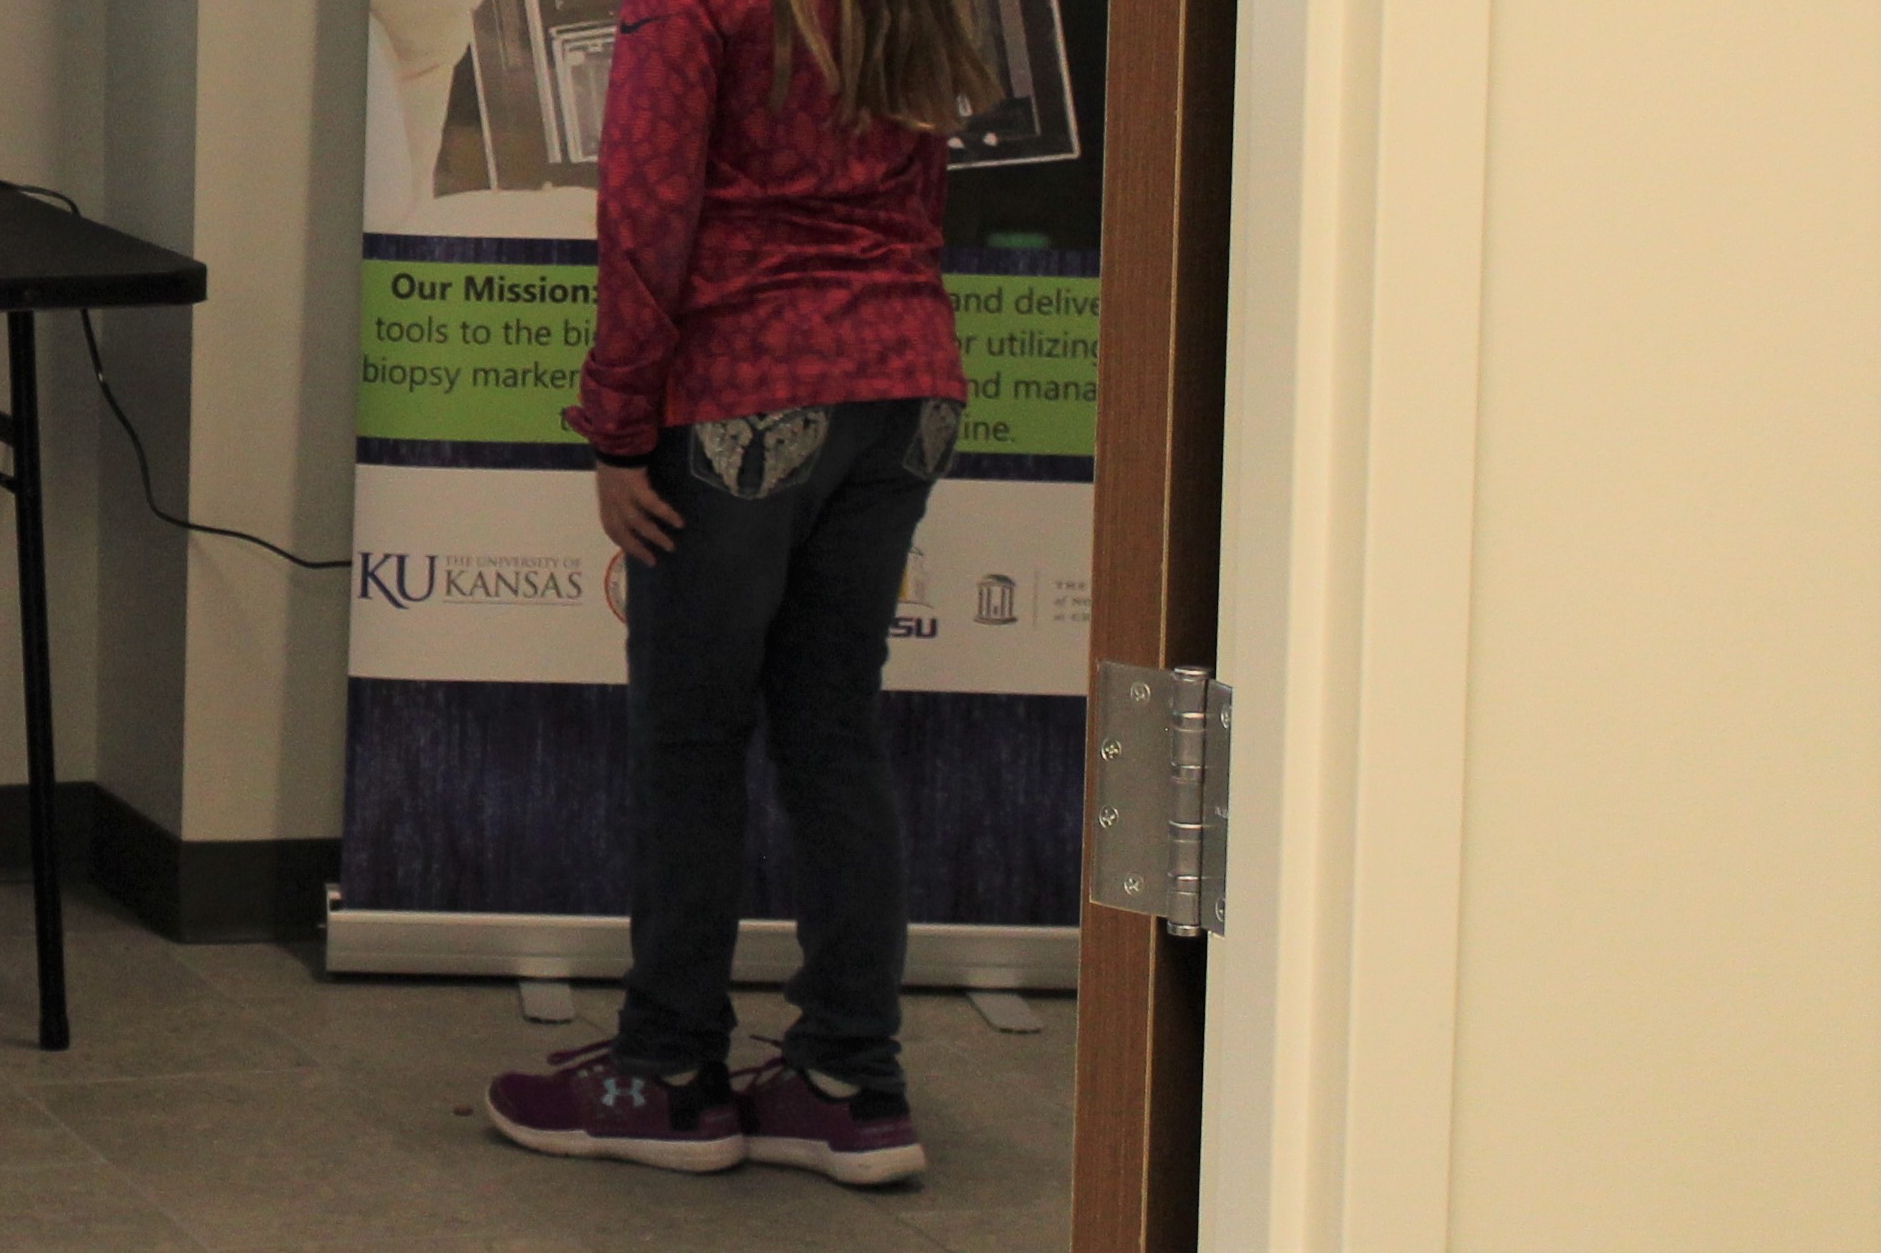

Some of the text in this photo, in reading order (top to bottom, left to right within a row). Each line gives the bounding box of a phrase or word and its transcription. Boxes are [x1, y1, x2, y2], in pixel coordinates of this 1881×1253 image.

[391, 273, 453, 300] Our
[375, 316, 449, 344] tools
[460, 319, 491, 345] to
[502, 317, 551, 346] the
[362, 354, 461, 394] biopsy
[358, 552, 439, 609] KU
[444, 570, 583, 600] KANSAS
